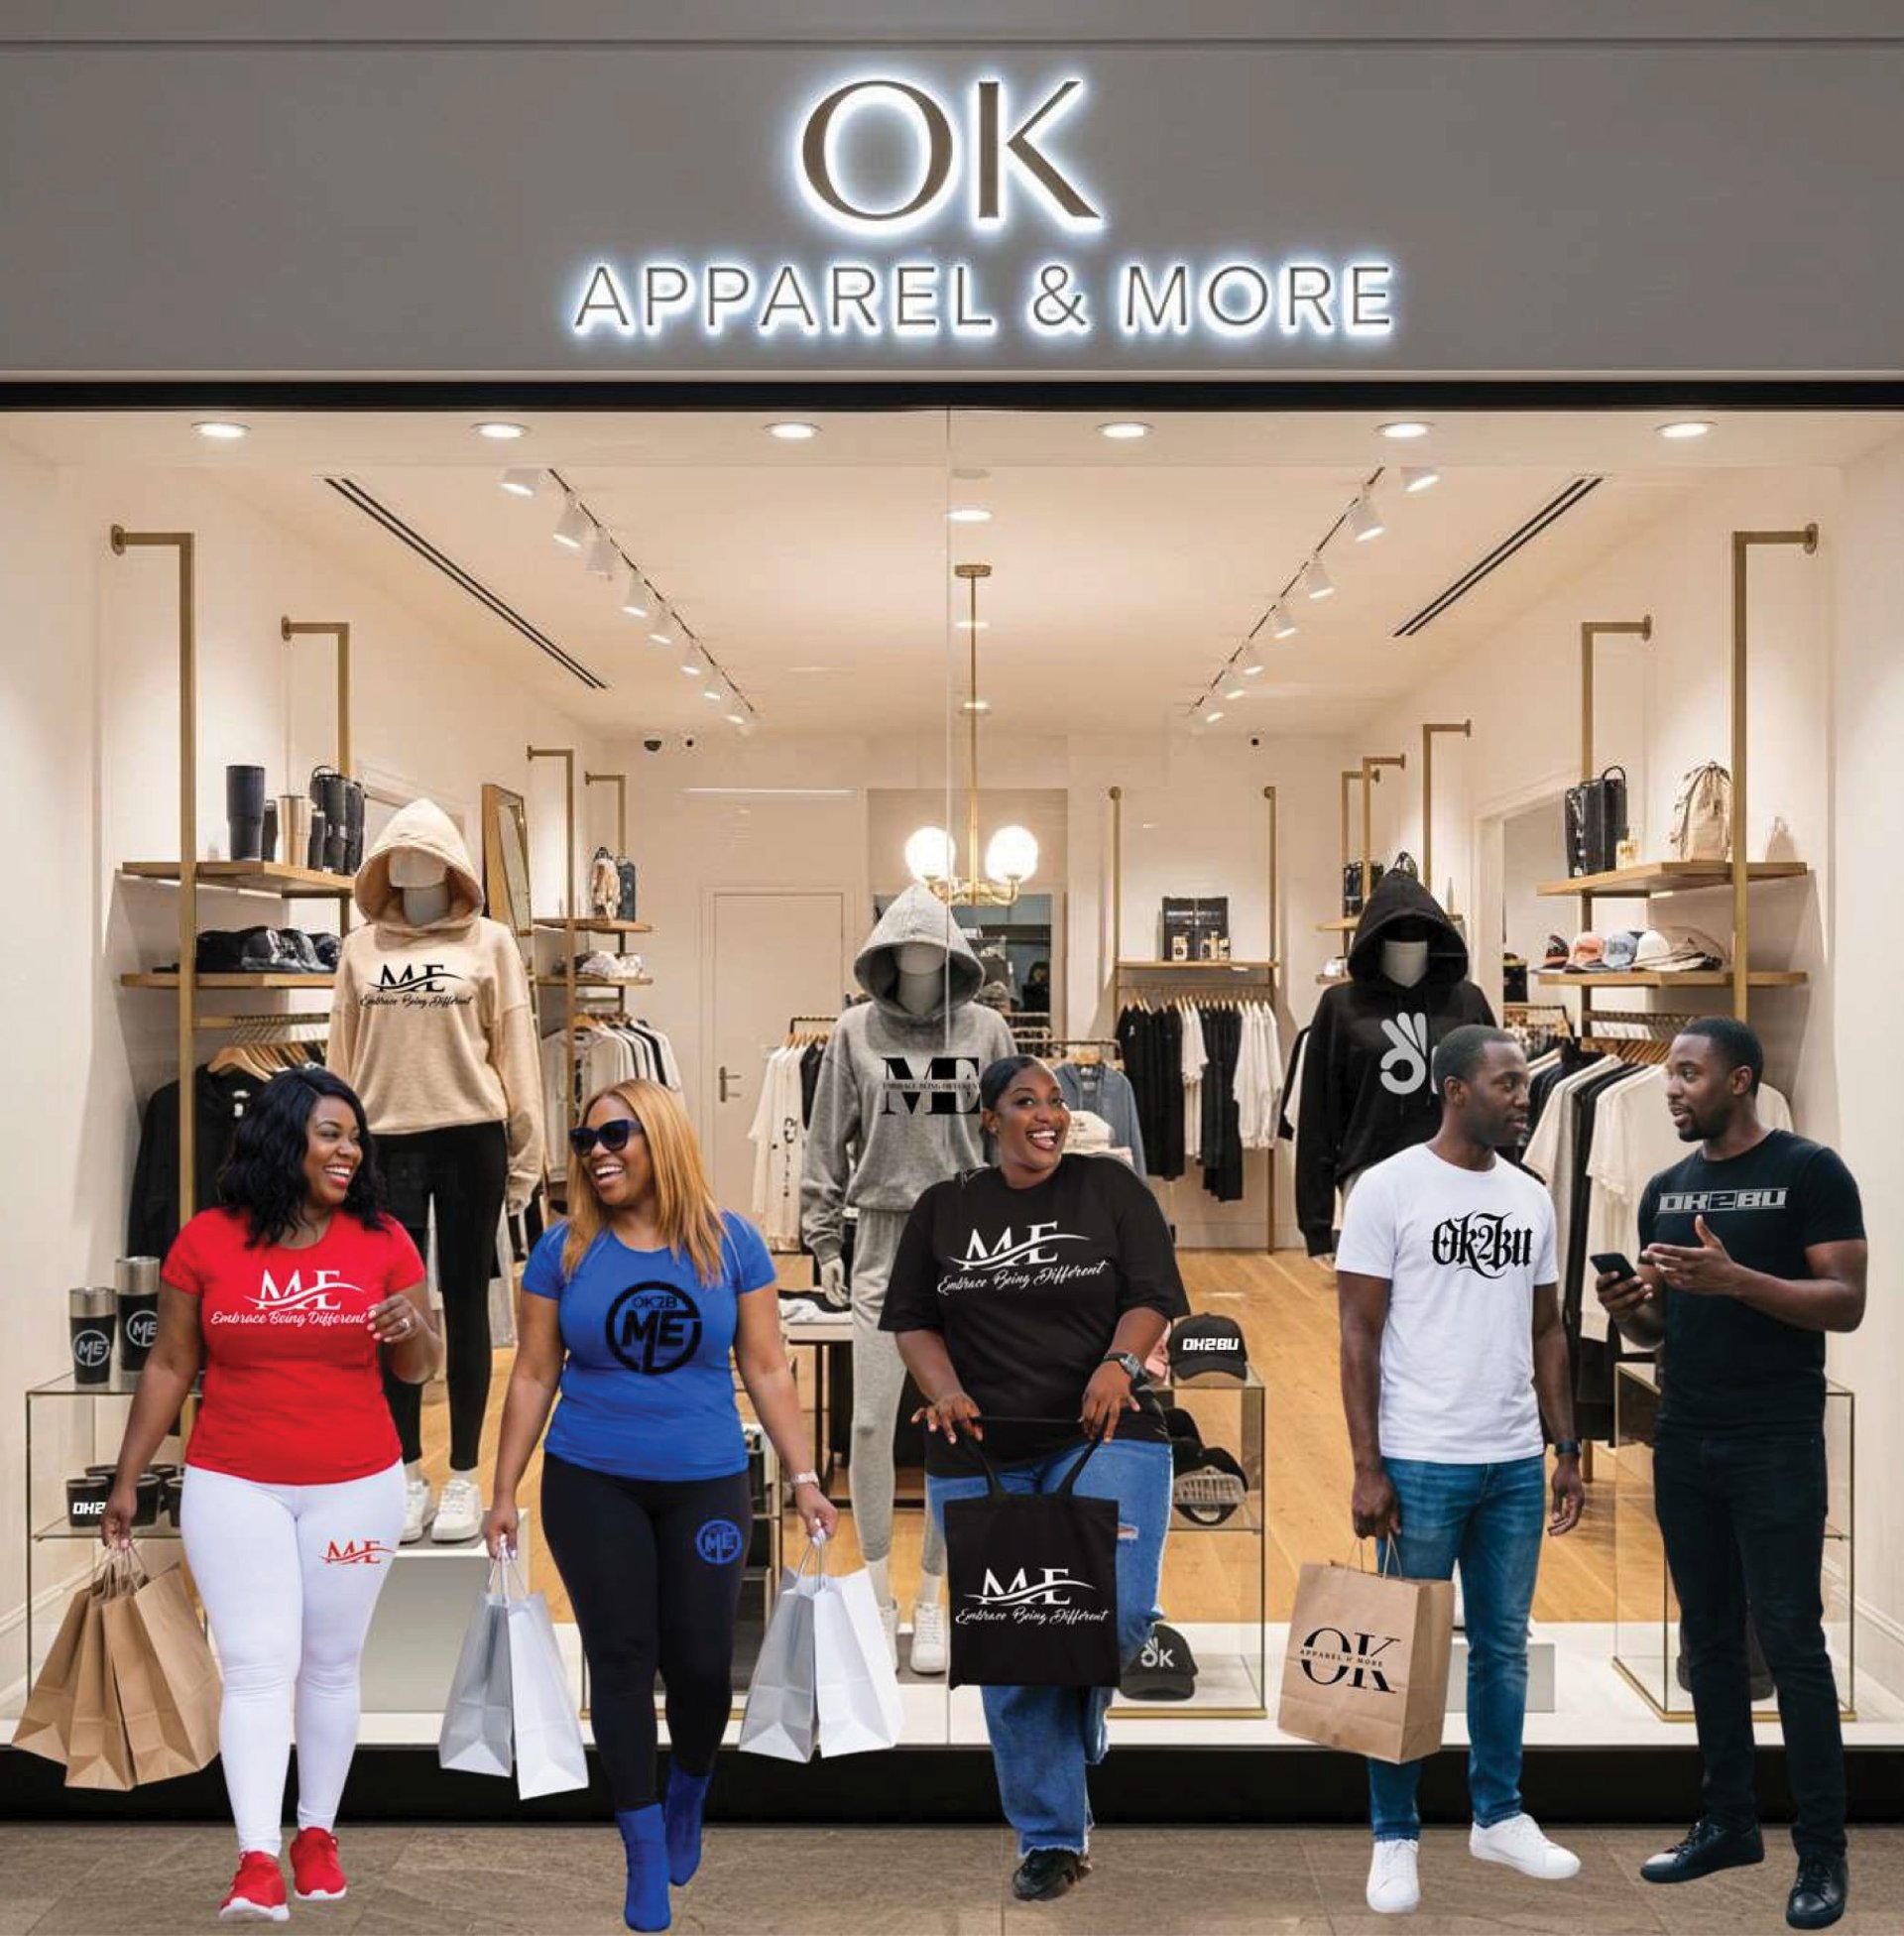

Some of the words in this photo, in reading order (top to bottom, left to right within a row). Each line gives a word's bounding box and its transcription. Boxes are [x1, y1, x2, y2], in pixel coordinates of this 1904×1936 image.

[802, 79, 1101, 221] OK
[575, 265, 993, 326] APPAREL
[1033, 265, 1087, 326] &
[1127, 265, 1390, 326] MORE
[379, 964, 445, 993] ME
[403, 994, 426, 1009] Being
[881, 1057, 981, 1115] ME
[960, 1221, 1059, 1271] ME
[255, 1269, 342, 1310] ME
[937, 1274, 988, 1296] Embrace
[993, 1270, 1030, 1289] Being
[1032, 1260, 1110, 1286] Different
[132, 1321, 158, 1341] ME
[210, 1310, 267, 1325] Embrace
[269, 1310, 307, 1327] Being
[308, 1309, 367, 1325] Different
[622, 1310, 688, 1357] ME
[78, 1341, 104, 1360] ME
[325, 1540, 381, 1564] ME
[978, 1568, 1071, 1606] ME
[955, 1609, 1007, 1625] Embrace
[1012, 1606, 1046, 1625] Being
[1049, 1608, 1110, 1625] Different
[1300, 1648, 1341, 1661] APPAREL
[1358, 1657, 1383, 1667] MORE
[1301, 1628, 1401, 1694] OK
